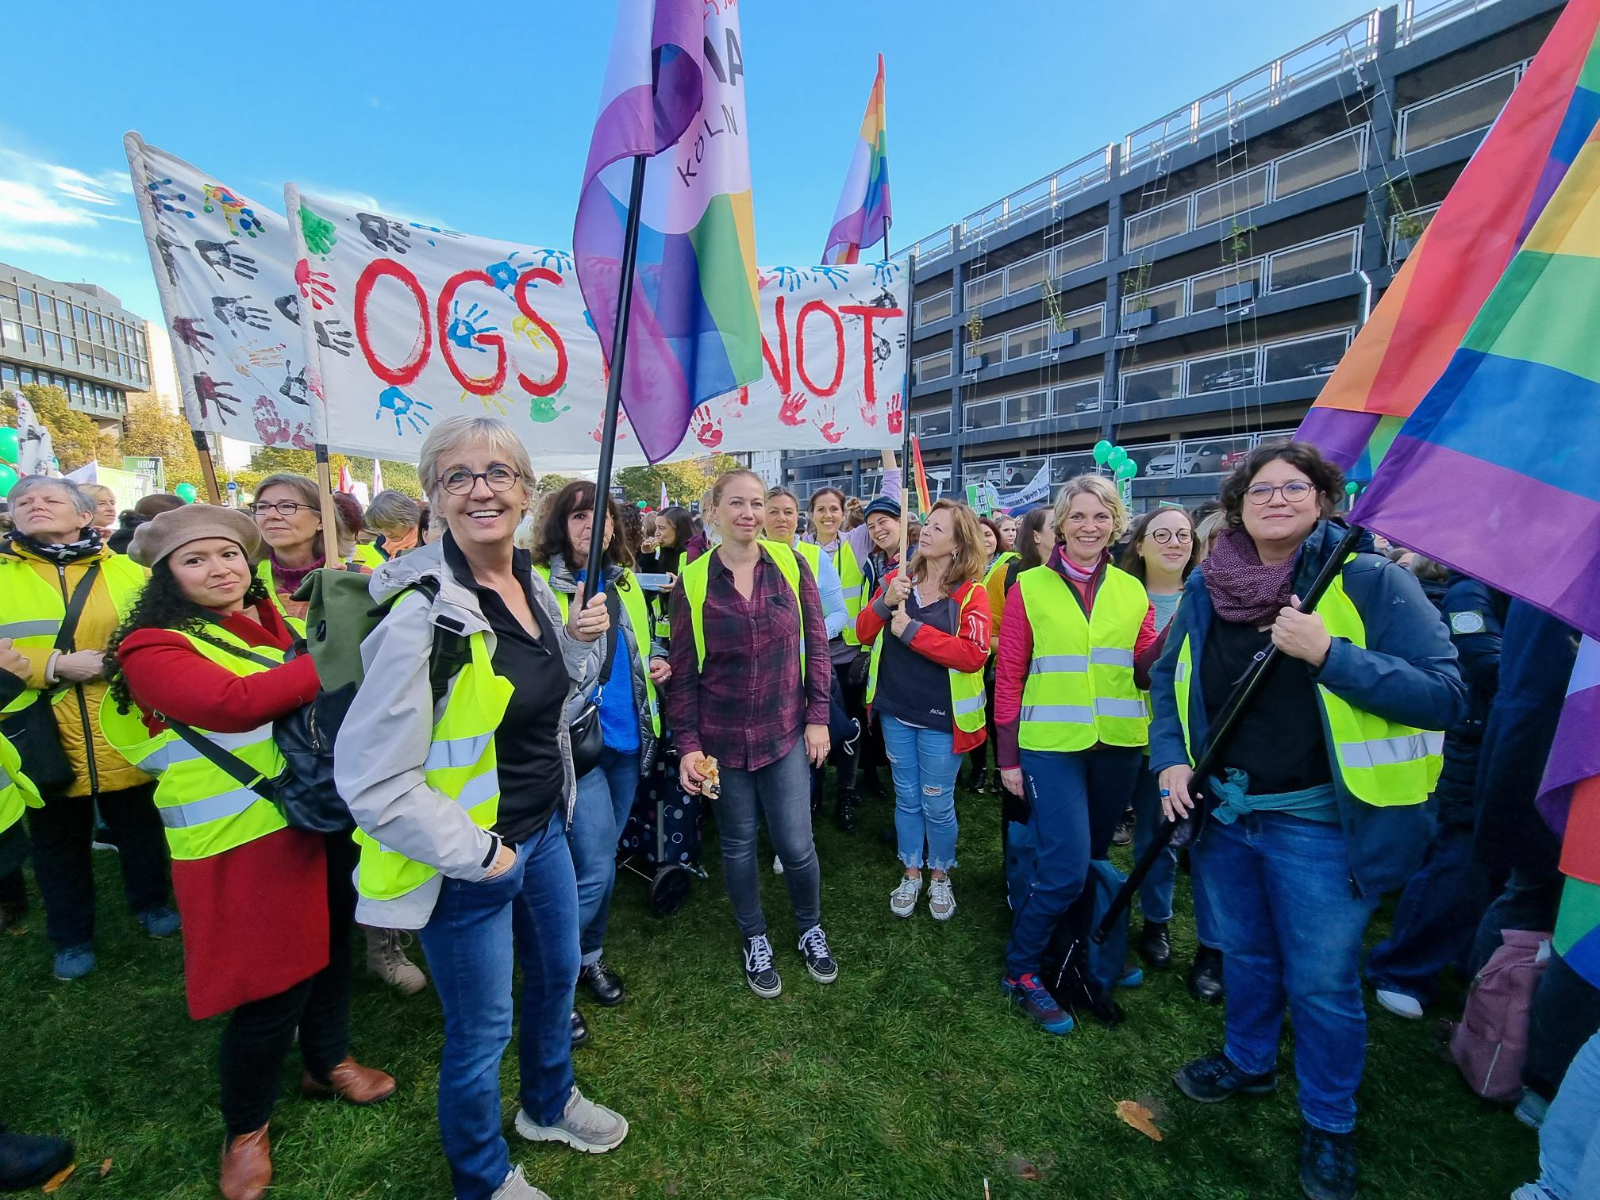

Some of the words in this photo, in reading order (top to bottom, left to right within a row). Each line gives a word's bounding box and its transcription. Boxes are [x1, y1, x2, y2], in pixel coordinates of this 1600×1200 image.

[676, 103, 738, 188] KÖLN
[354, 258, 568, 397] OGS
[137, 460, 155, 469] NRW
